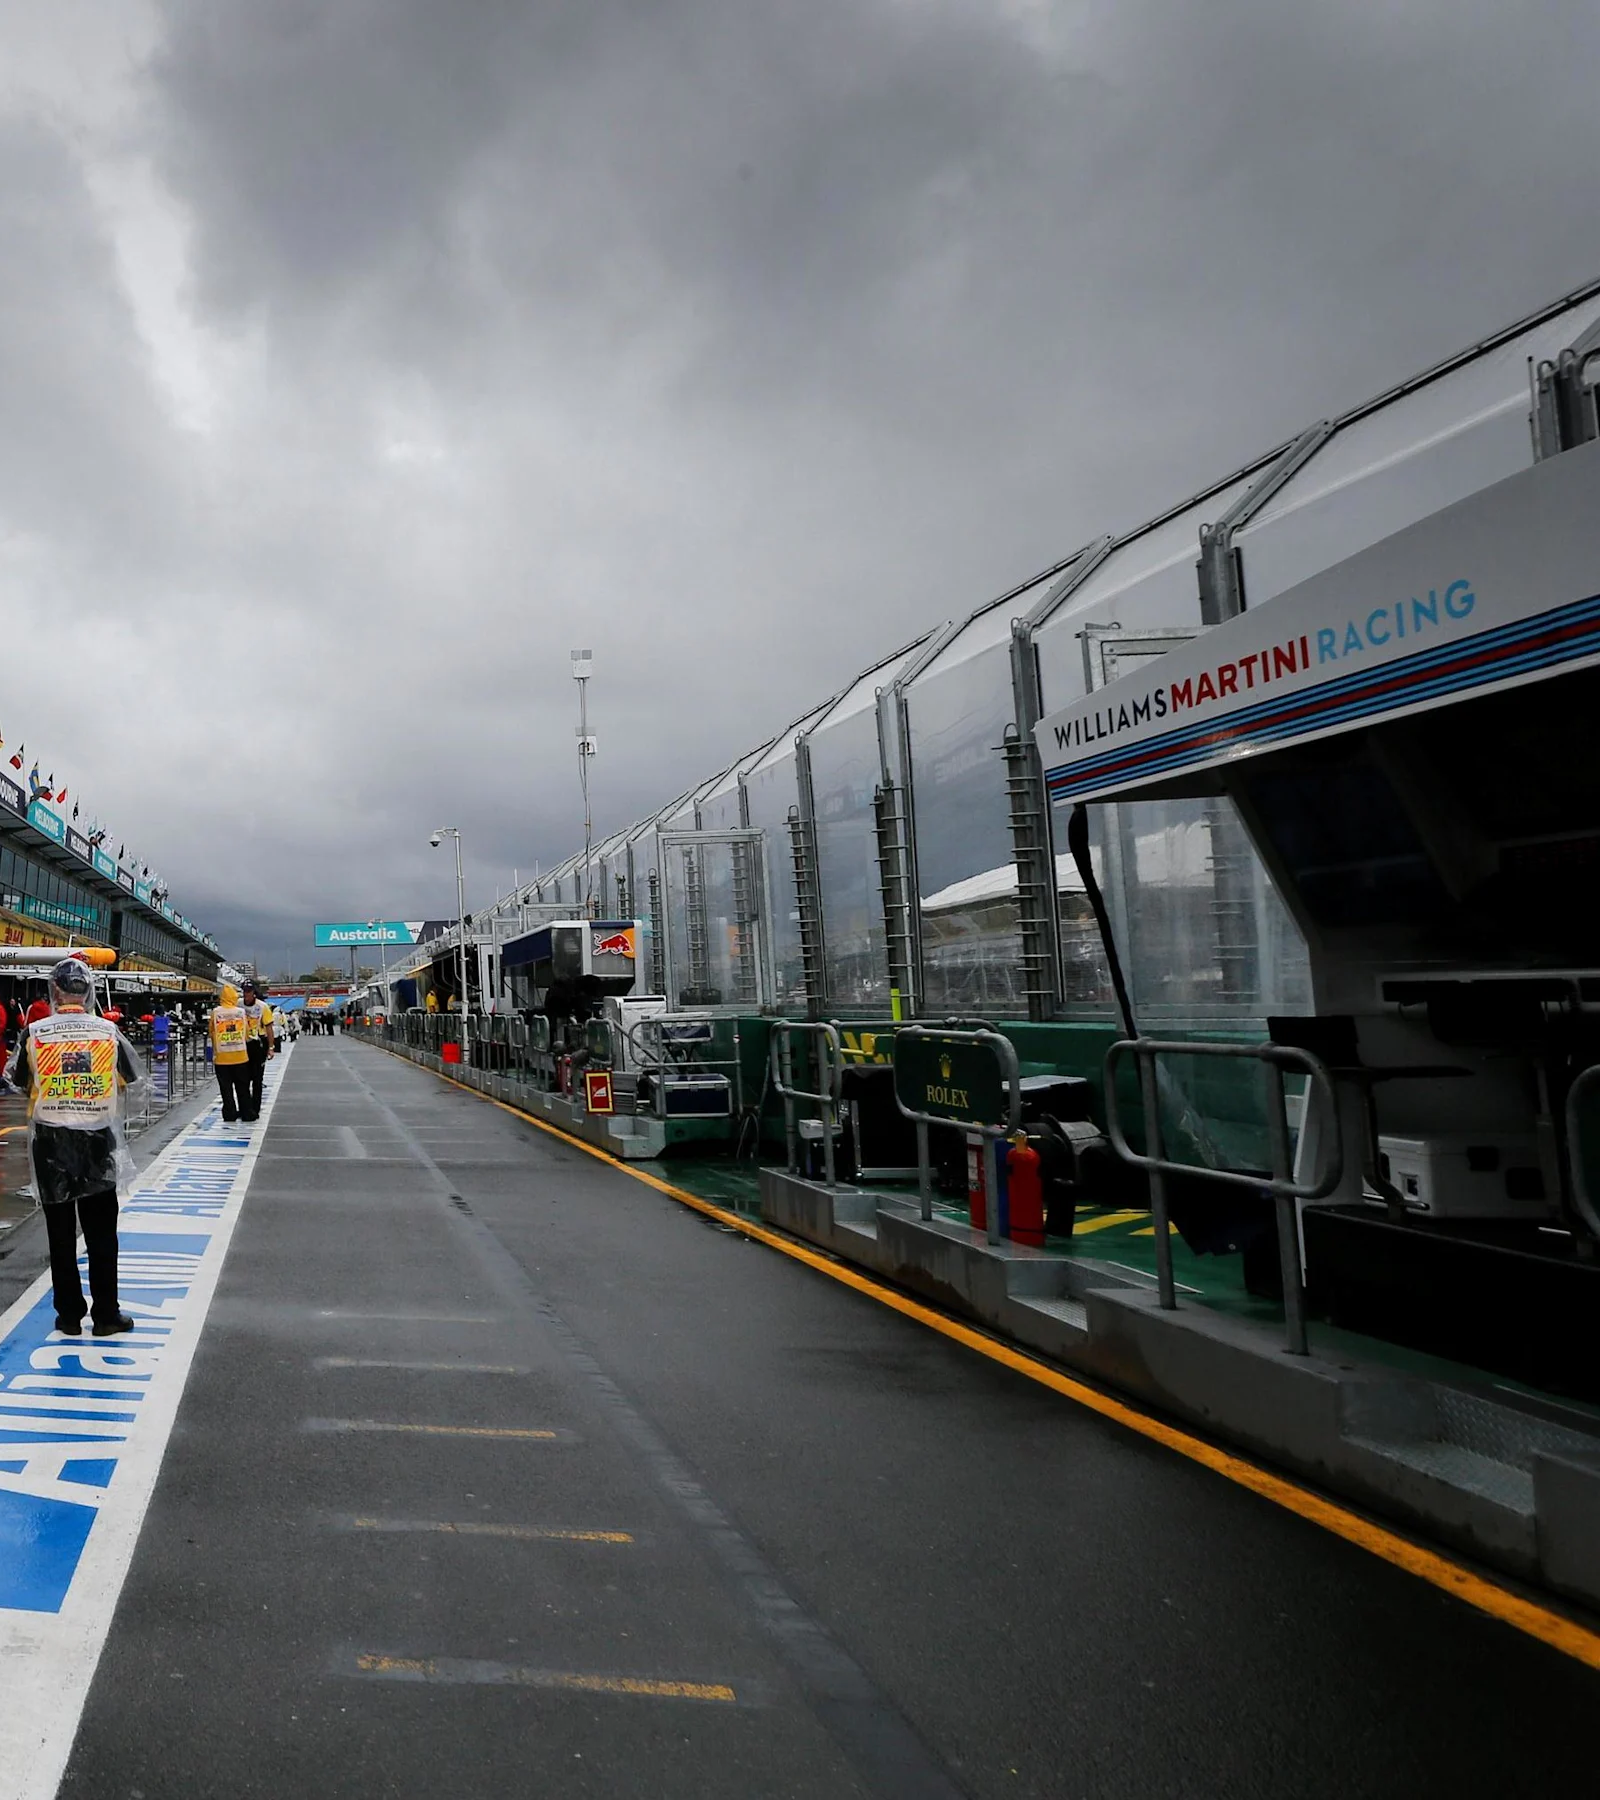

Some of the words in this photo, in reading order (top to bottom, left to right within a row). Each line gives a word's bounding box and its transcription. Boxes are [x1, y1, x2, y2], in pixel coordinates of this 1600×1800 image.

[1055, 688, 1168, 750] WILLIAMS
[1170, 636, 1311, 713] MARTINI
[1318, 579, 1476, 664] RACING
[329, 929, 397, 941] Australia
[926, 1084, 970, 1109] ROLEX
[120, 1167, 239, 1218] Allianz
